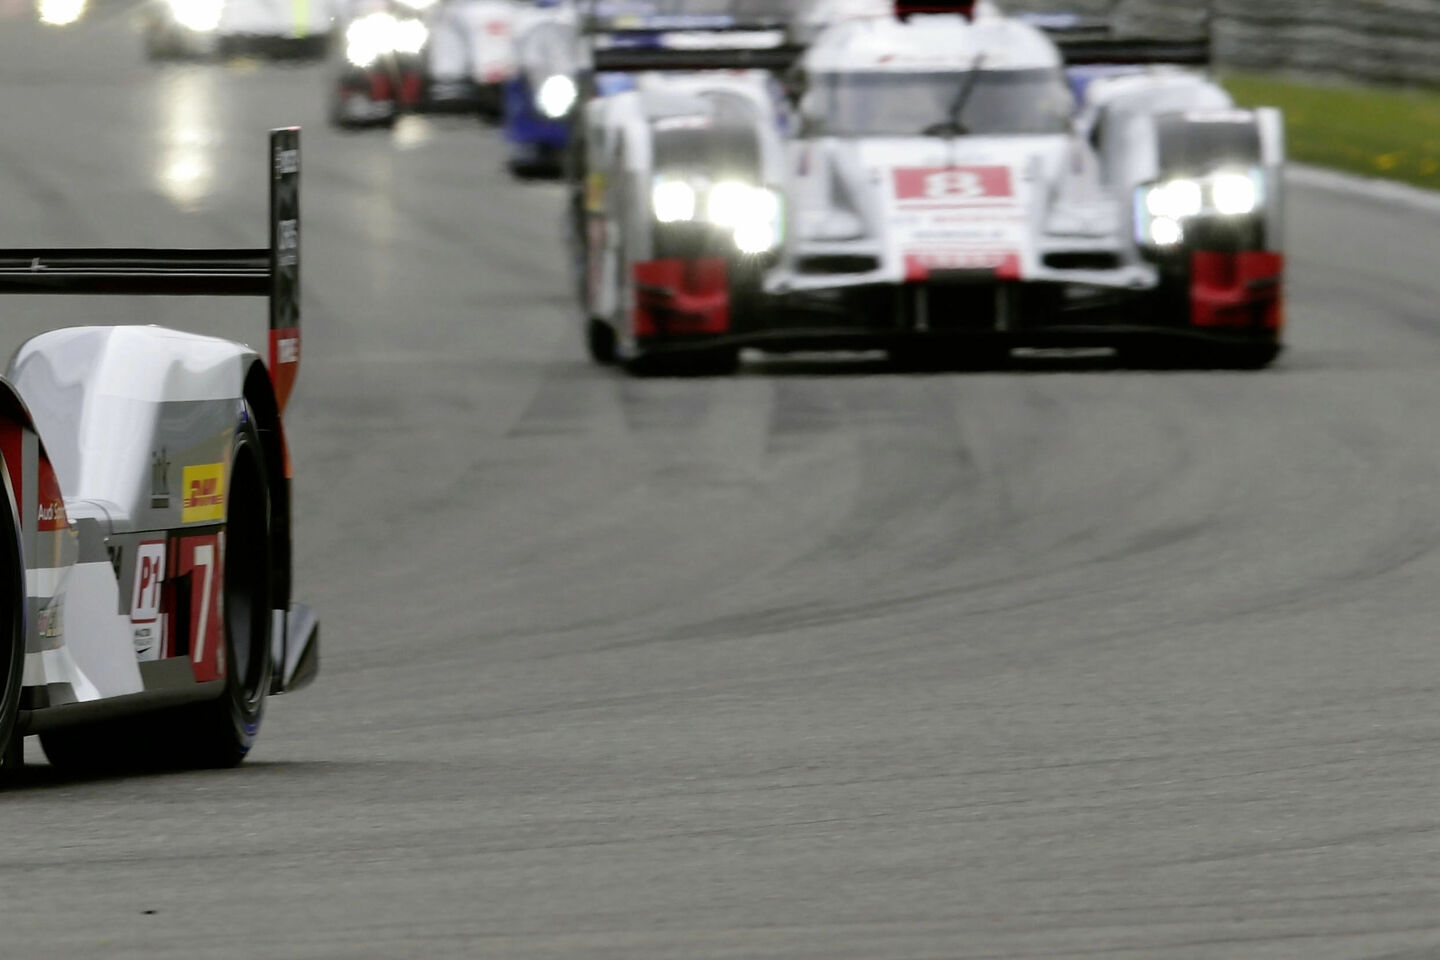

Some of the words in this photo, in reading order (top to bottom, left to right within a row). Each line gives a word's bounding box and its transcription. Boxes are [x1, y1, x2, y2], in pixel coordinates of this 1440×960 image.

[925, 172, 987, 199] 8
[187, 478, 220, 507] DHL
[137, 556, 160, 610] P1
[192, 544, 215, 663] 7
